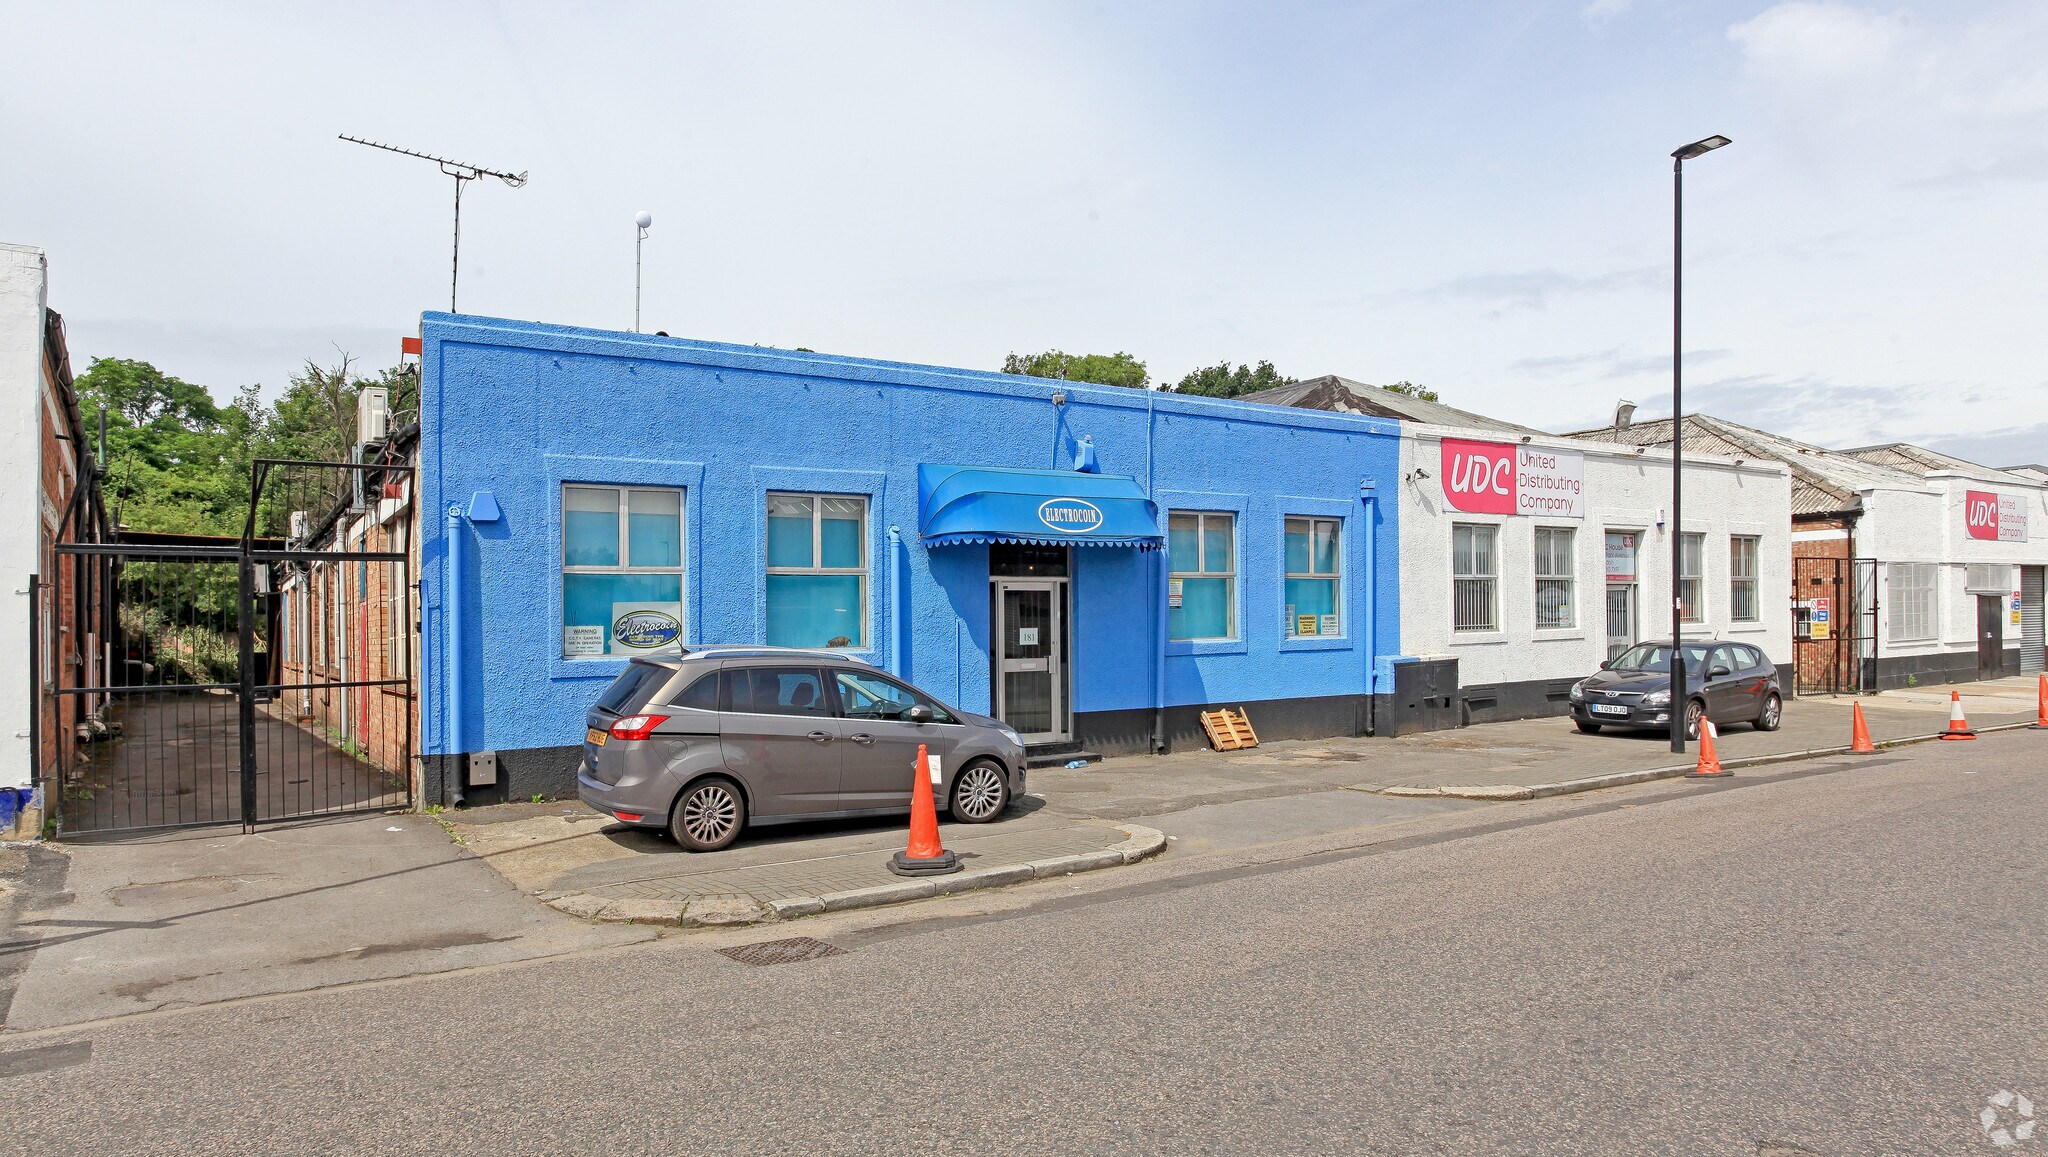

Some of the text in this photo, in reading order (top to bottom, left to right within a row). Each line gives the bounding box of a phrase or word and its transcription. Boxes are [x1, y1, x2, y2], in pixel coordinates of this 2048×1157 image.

[1519, 452, 1556, 470] United
[1450, 453, 1511, 496] UDC
[1519, 472, 1581, 495] Distributing
[1519, 493, 1574, 513] Company
[1999, 499, 2016, 510] United
[1044, 507, 1097, 523] ELECTROCOIN
[1969, 500, 1996, 528] UDC
[1999, 512, 2027, 527] Distributing
[1999, 526, 2024, 539] Company
[616, 617, 678, 640] Electrocoin
[1024, 633, 1035, 642] 181
[1596, 705, 1613, 713] LT09
